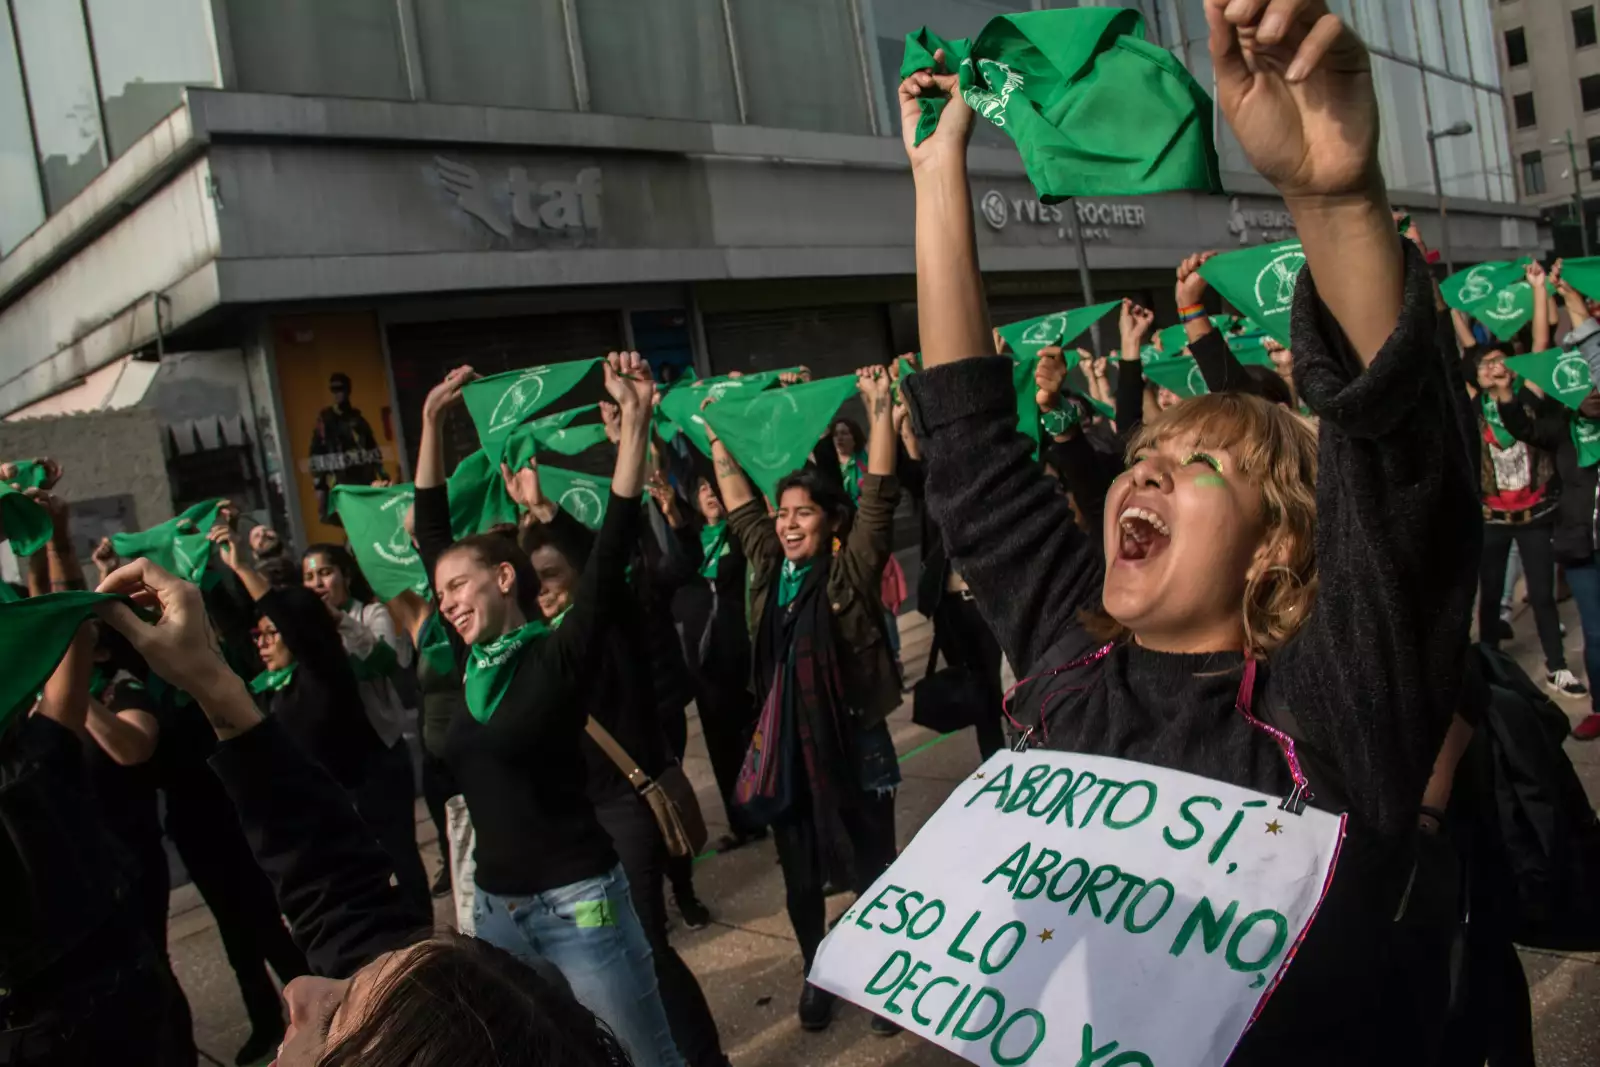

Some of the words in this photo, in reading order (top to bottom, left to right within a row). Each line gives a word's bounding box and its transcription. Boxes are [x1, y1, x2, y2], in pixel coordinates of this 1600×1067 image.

[509, 167, 602, 230] taf
[1010, 198, 1063, 223] YVES
[965, 764, 1158, 830] ABORTO
[1163, 797, 1268, 875] SÍ,
[946, 911, 1027, 976] LO
[983, 842, 1175, 934] ABORTO
[1169, 896, 1289, 989] NO,
[864, 950, 1047, 1067] DECIDO
